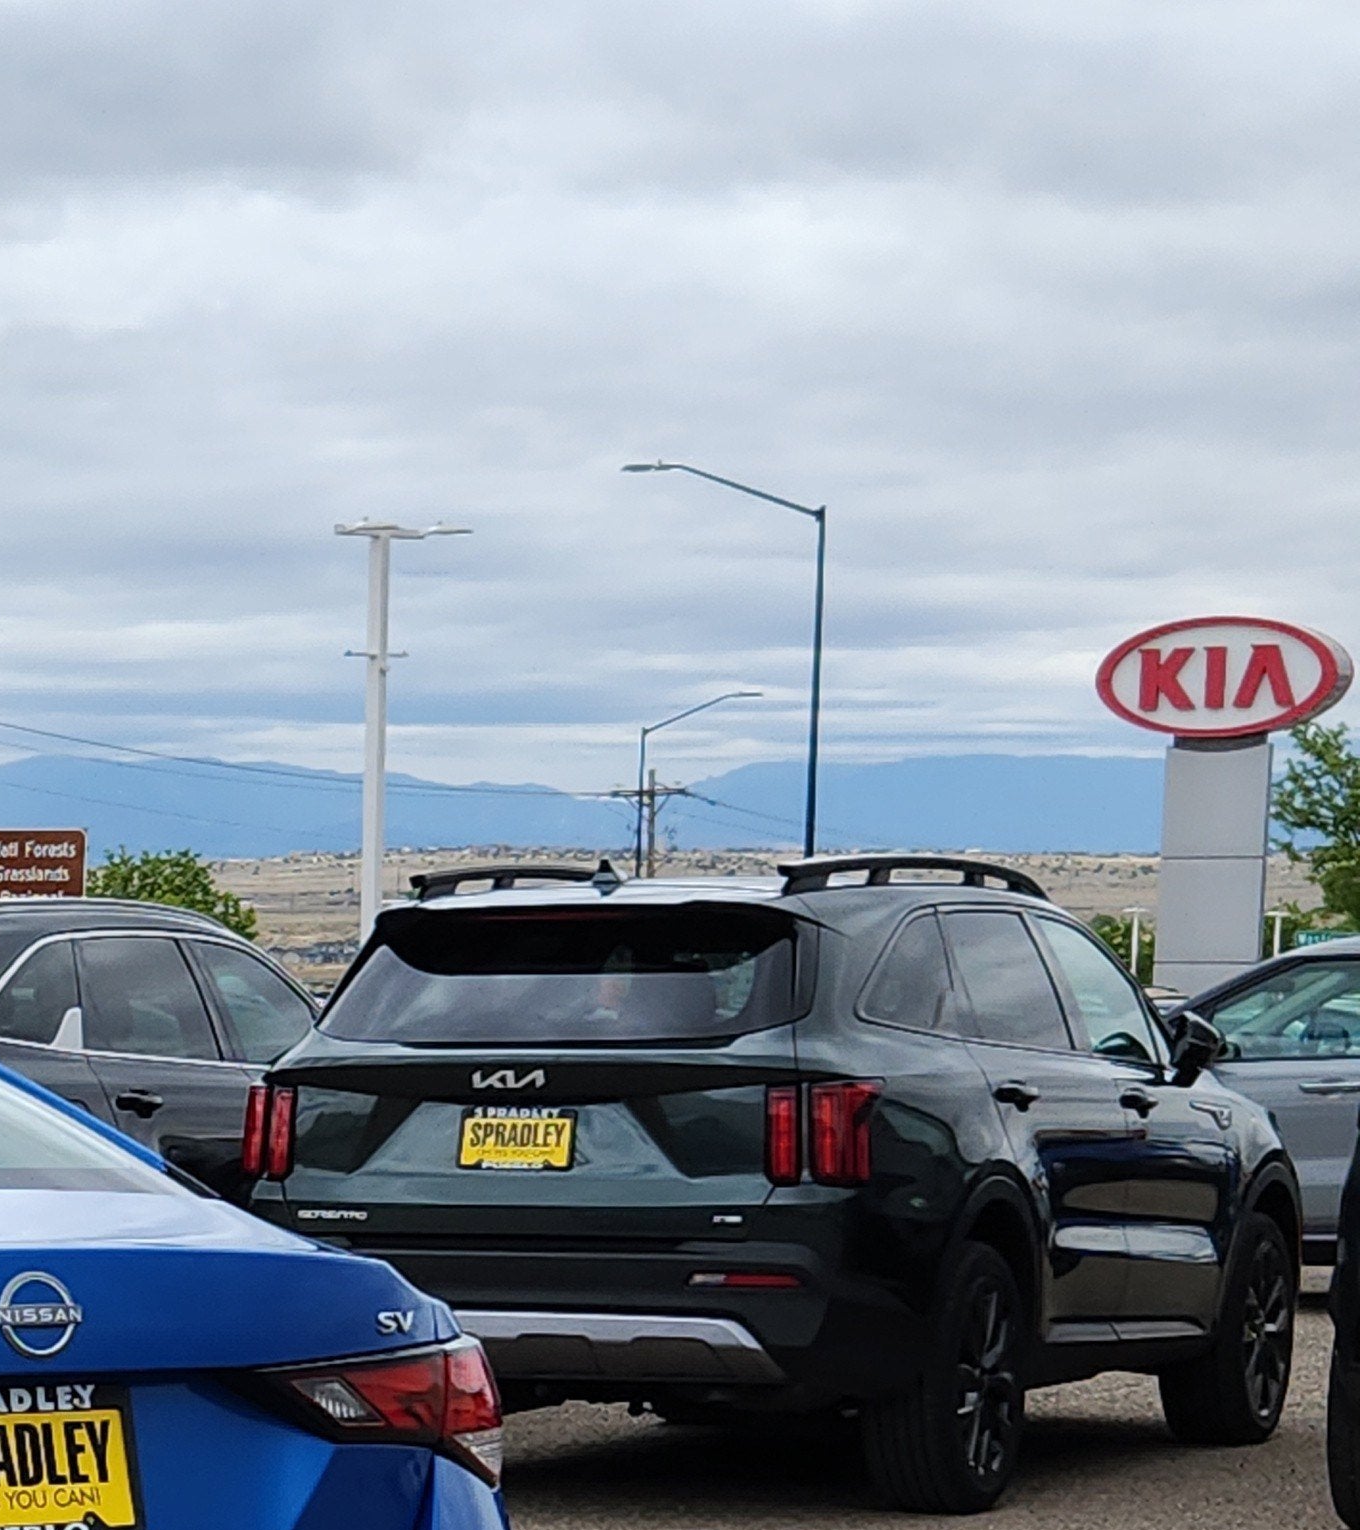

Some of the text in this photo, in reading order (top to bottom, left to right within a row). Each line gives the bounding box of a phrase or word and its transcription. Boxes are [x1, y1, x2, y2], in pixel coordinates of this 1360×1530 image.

[1138, 644, 1296, 712] KIA
[24, 840, 77, 858] Forests
[471, 1069, 546, 1089] KIA
[469, 1121, 566, 1148] SPRADLEY
[377, 1310, 414, 1334] SV
[2, 1490, 47, 1510] YOU
